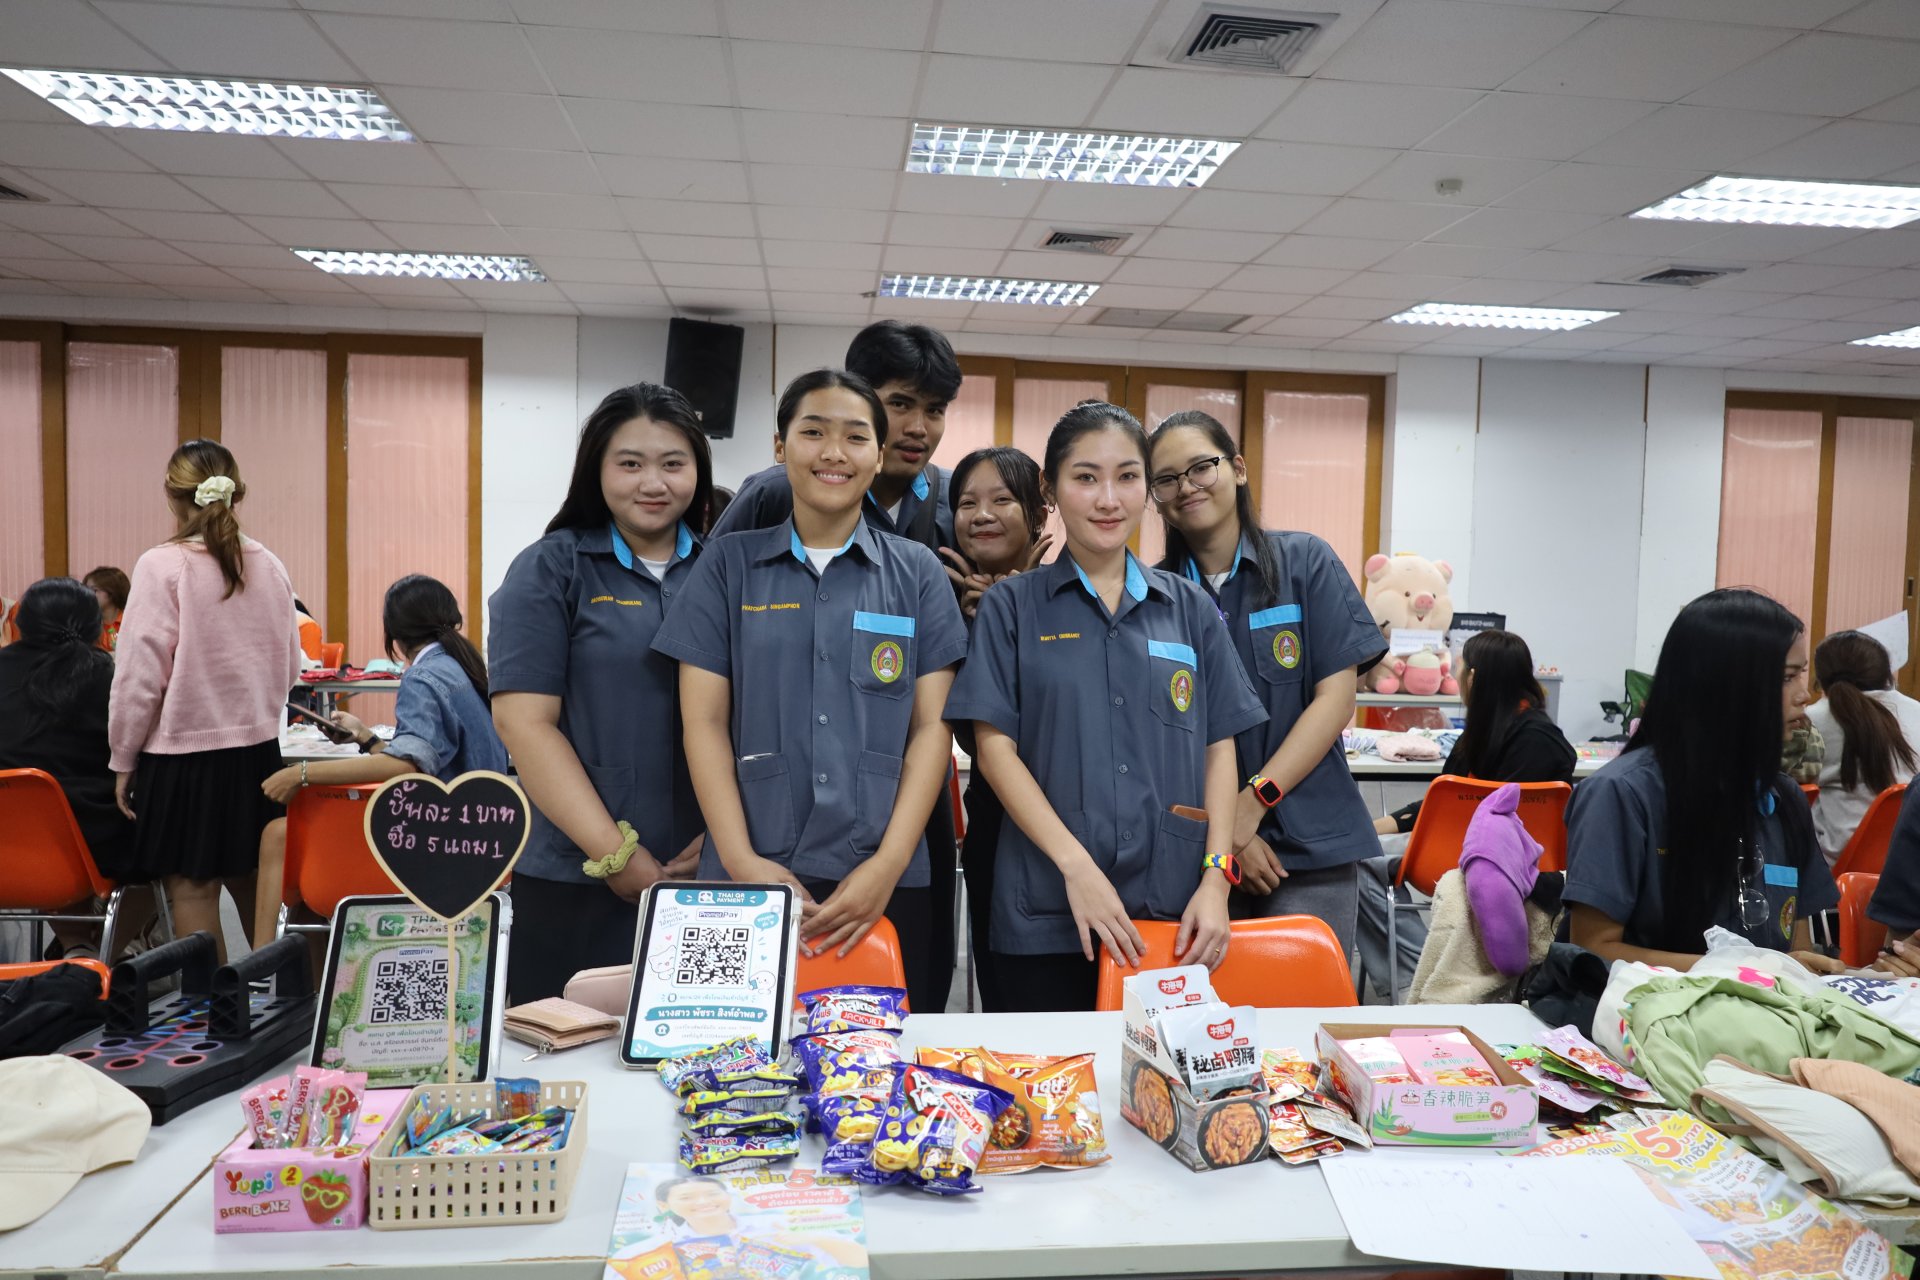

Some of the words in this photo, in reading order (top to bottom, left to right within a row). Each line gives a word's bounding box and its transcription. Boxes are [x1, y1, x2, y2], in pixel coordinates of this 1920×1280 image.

[476, 803, 516, 825] บาท
[388, 820, 417, 850] ซื้อ
[427, 836, 440, 853] 5
[1191, 1046, 1255, 1075] 秘卤鸭肠
[1422, 1088, 1491, 1108] 香辣脆笋
[1633, 1125, 1682, 1160] 5
[224, 1169, 274, 1197] Yupi
[286, 1166, 297, 1181] 2
[784, 1168, 817, 1189] 5
